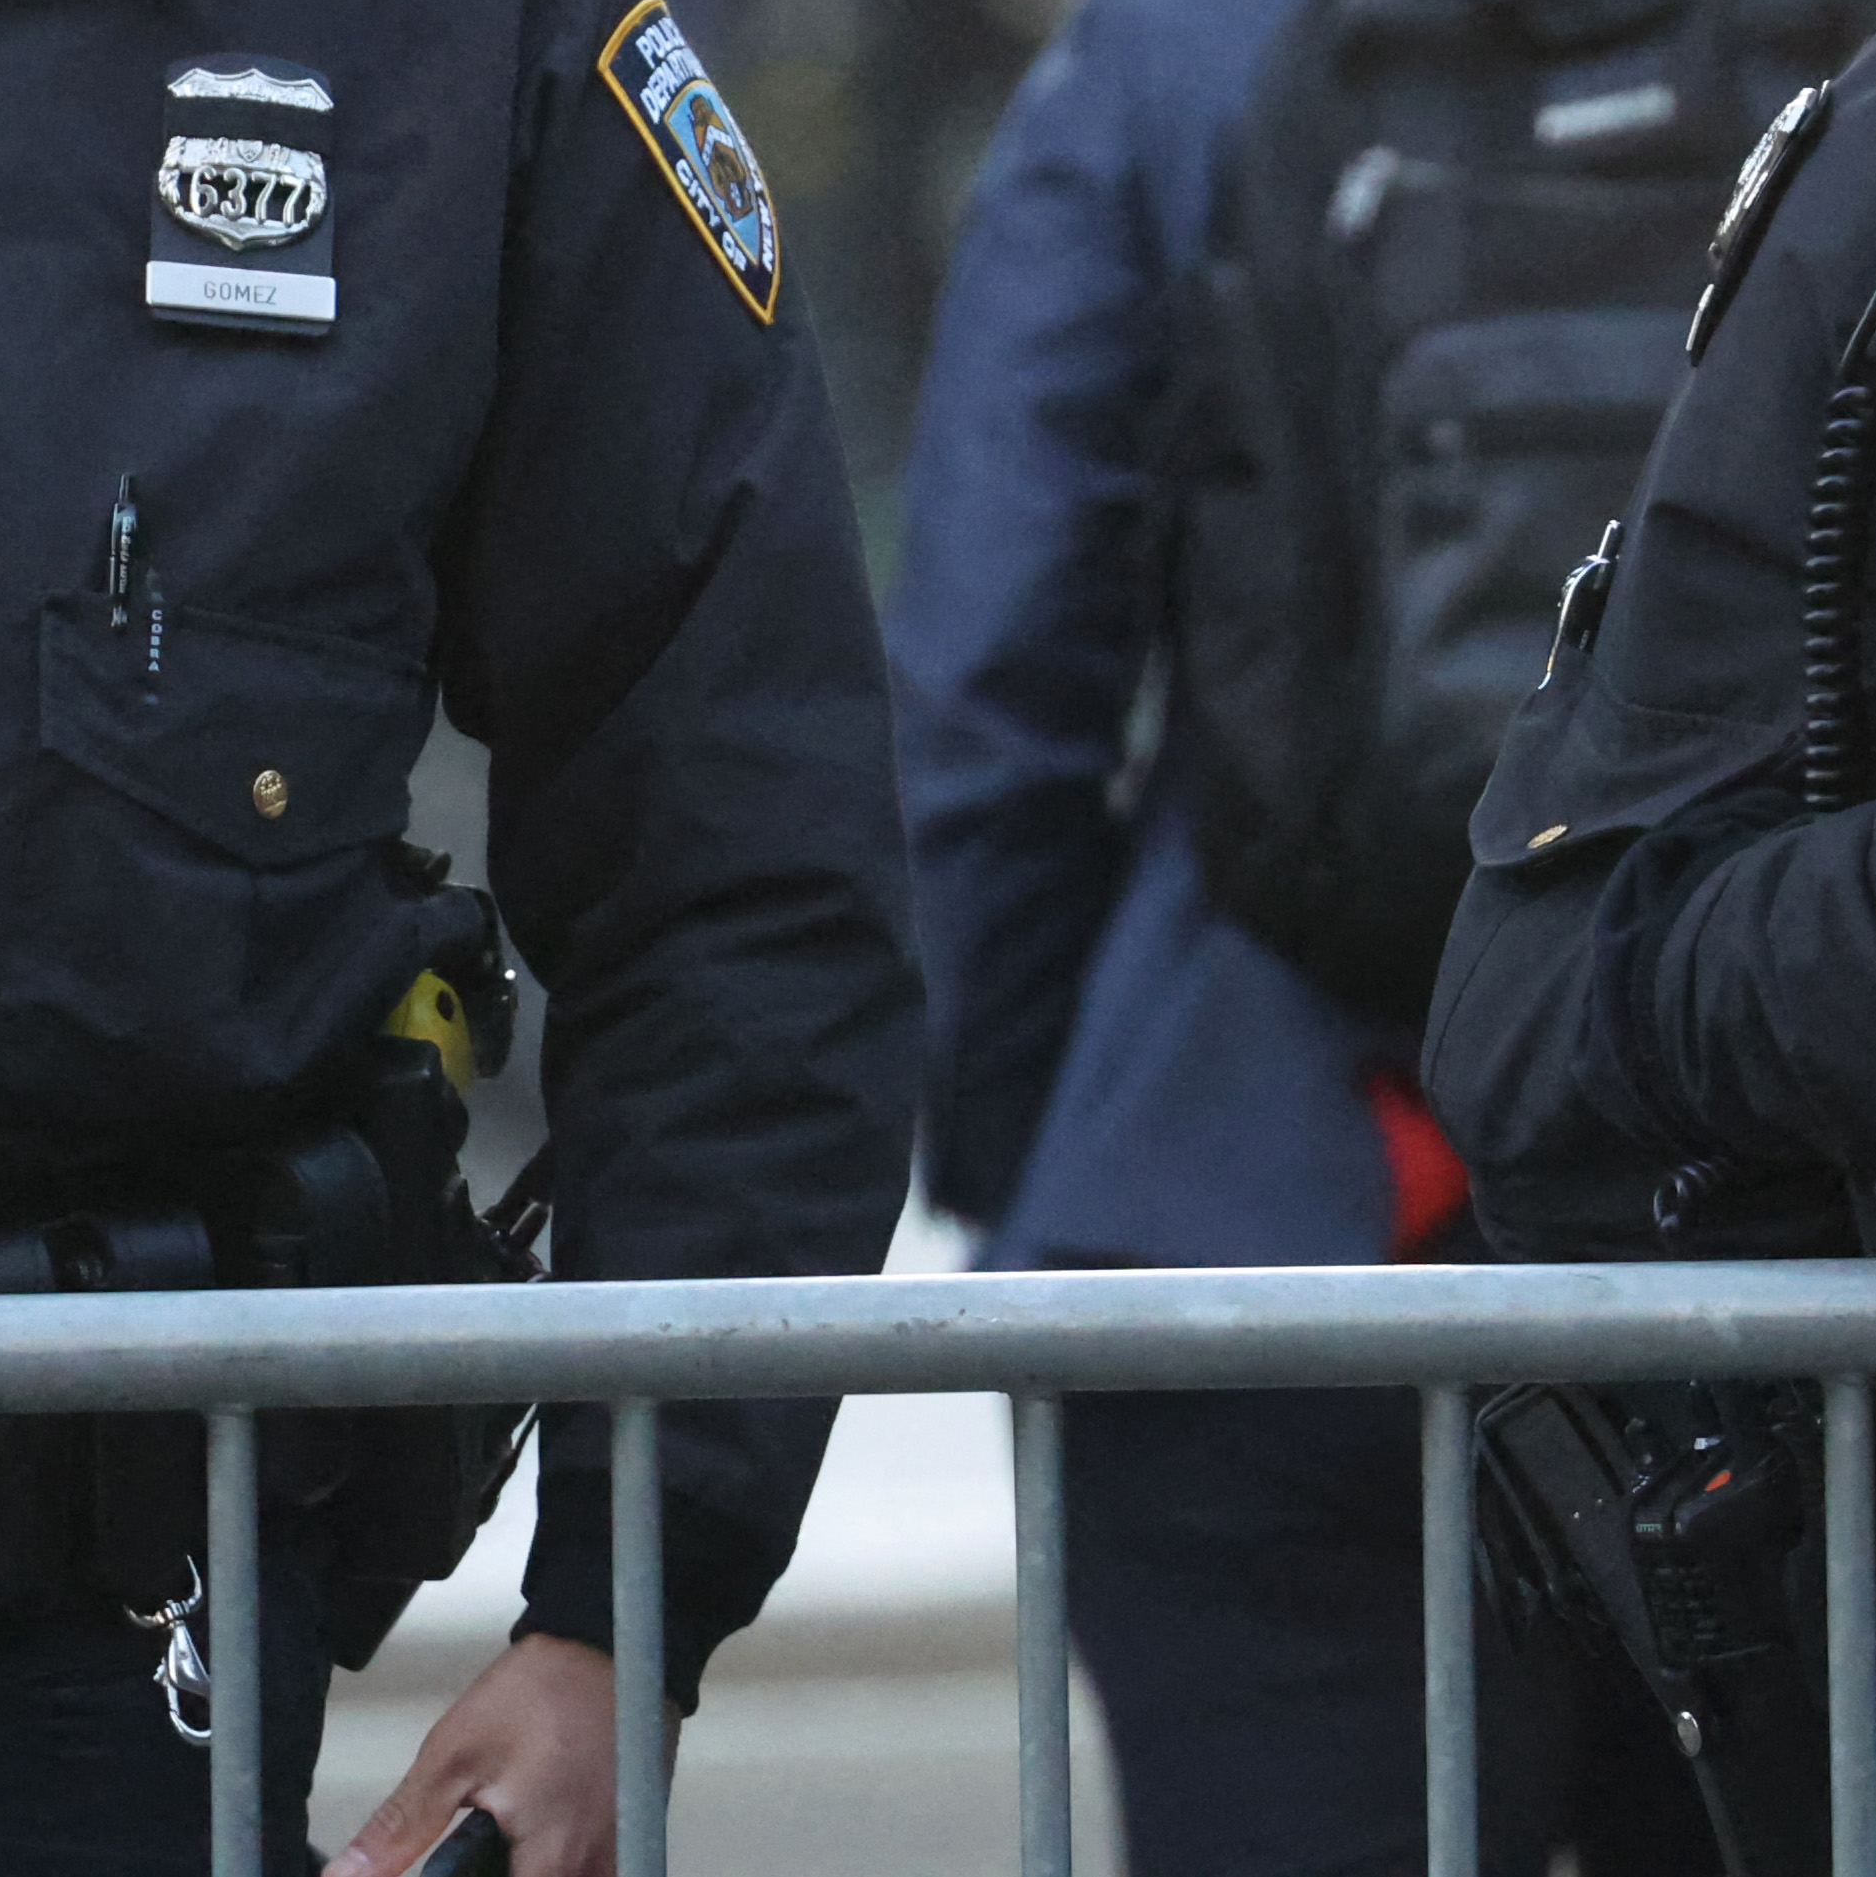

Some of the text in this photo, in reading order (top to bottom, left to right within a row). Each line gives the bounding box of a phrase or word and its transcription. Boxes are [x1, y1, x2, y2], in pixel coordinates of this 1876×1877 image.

[189, 165, 308, 226] 6377
[675, 158, 721, 227] CITY
[203, 280, 278, 306] GOMEZ
[148, 609, 163, 672] COBRA
